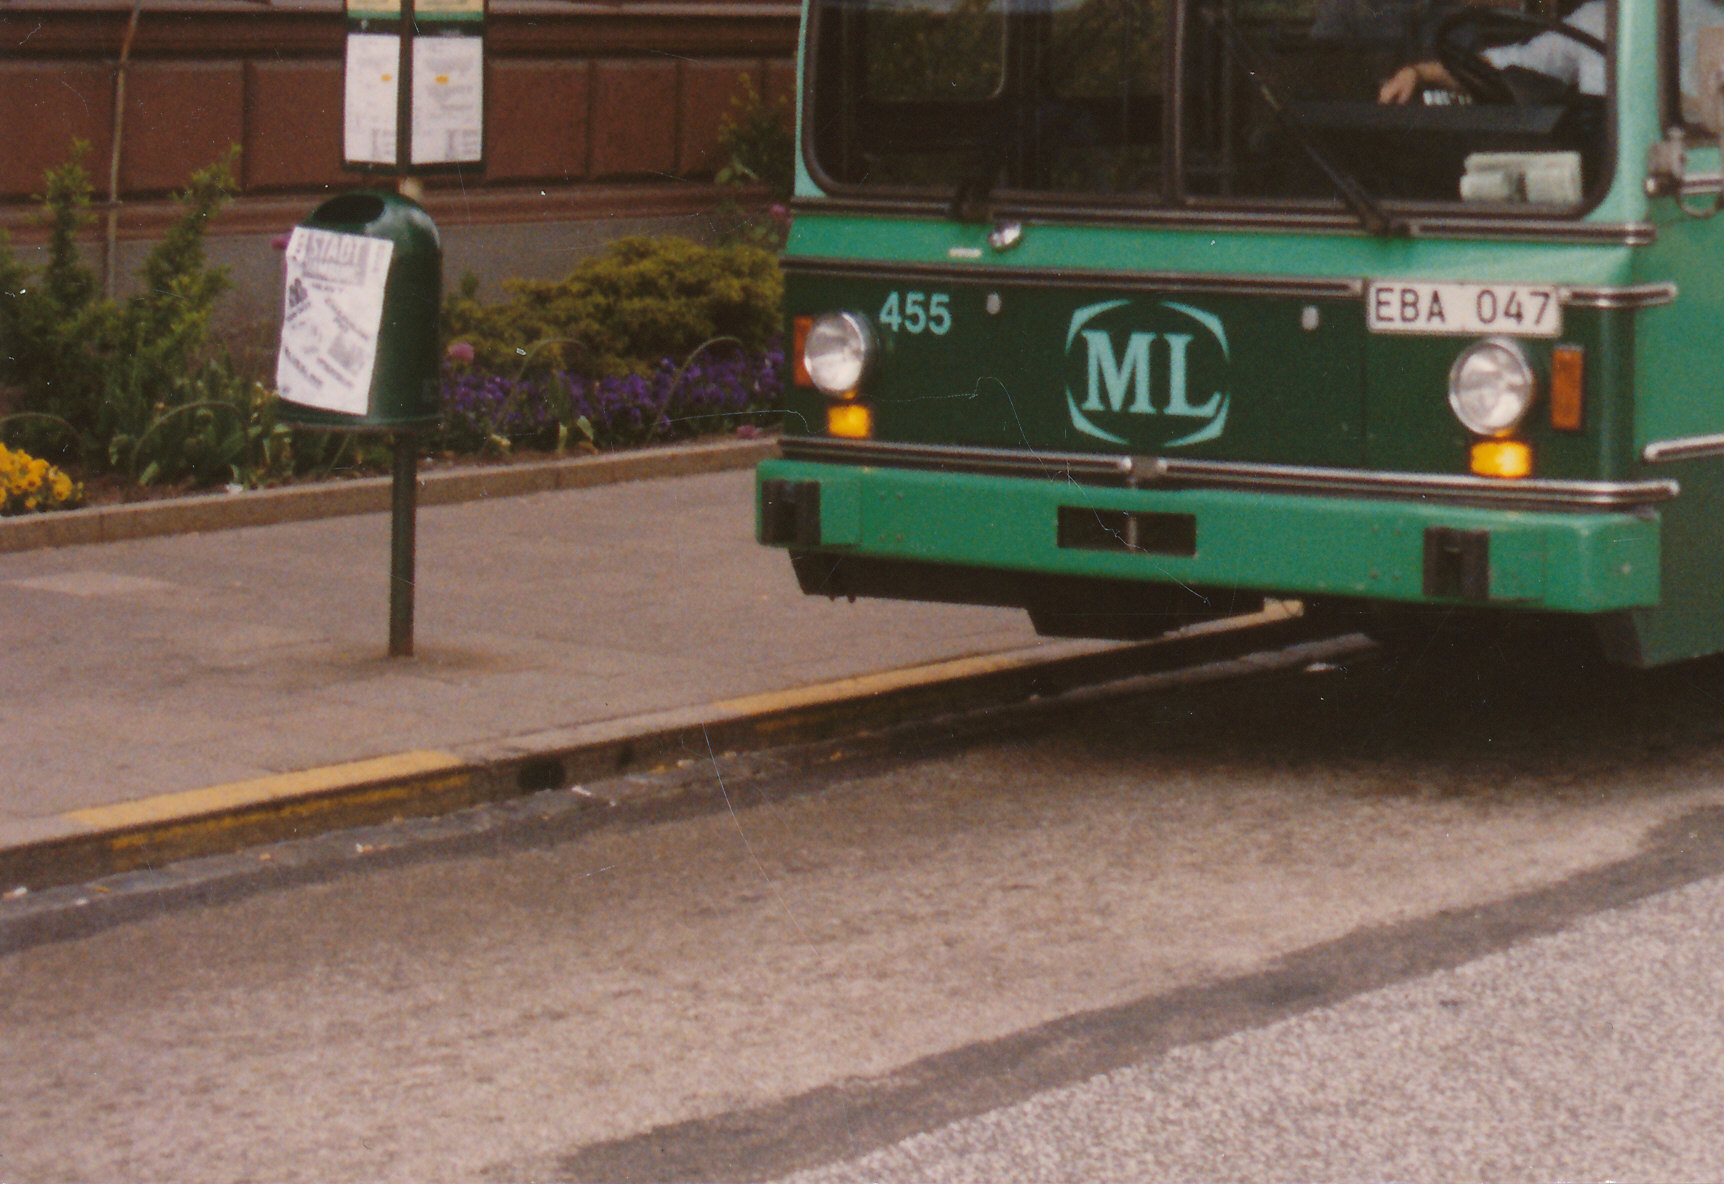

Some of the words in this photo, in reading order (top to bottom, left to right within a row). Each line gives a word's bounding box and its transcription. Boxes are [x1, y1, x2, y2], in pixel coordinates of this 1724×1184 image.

[878, 290, 953, 336] 455
[1374, 287, 1446, 323] EBA
[1476, 289, 1551, 325] 047
[1081, 329, 1224, 418] ML
